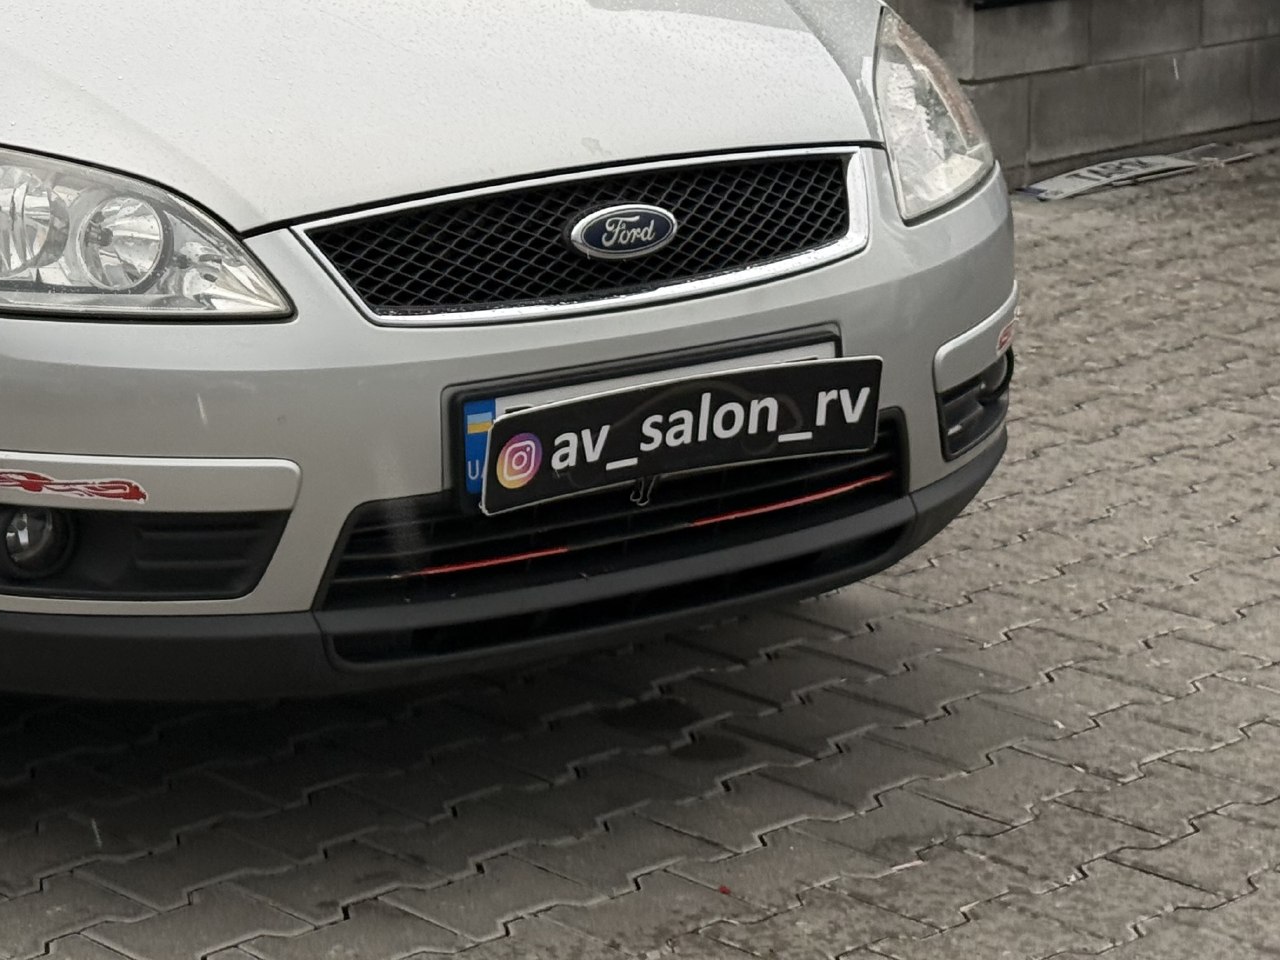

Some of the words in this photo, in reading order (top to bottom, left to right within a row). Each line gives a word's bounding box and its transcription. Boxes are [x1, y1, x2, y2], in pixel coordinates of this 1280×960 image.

[601, 215, 656, 248] Ford
[551, 386, 871, 471] av_salon_rv
[467, 459, 485, 480] U
